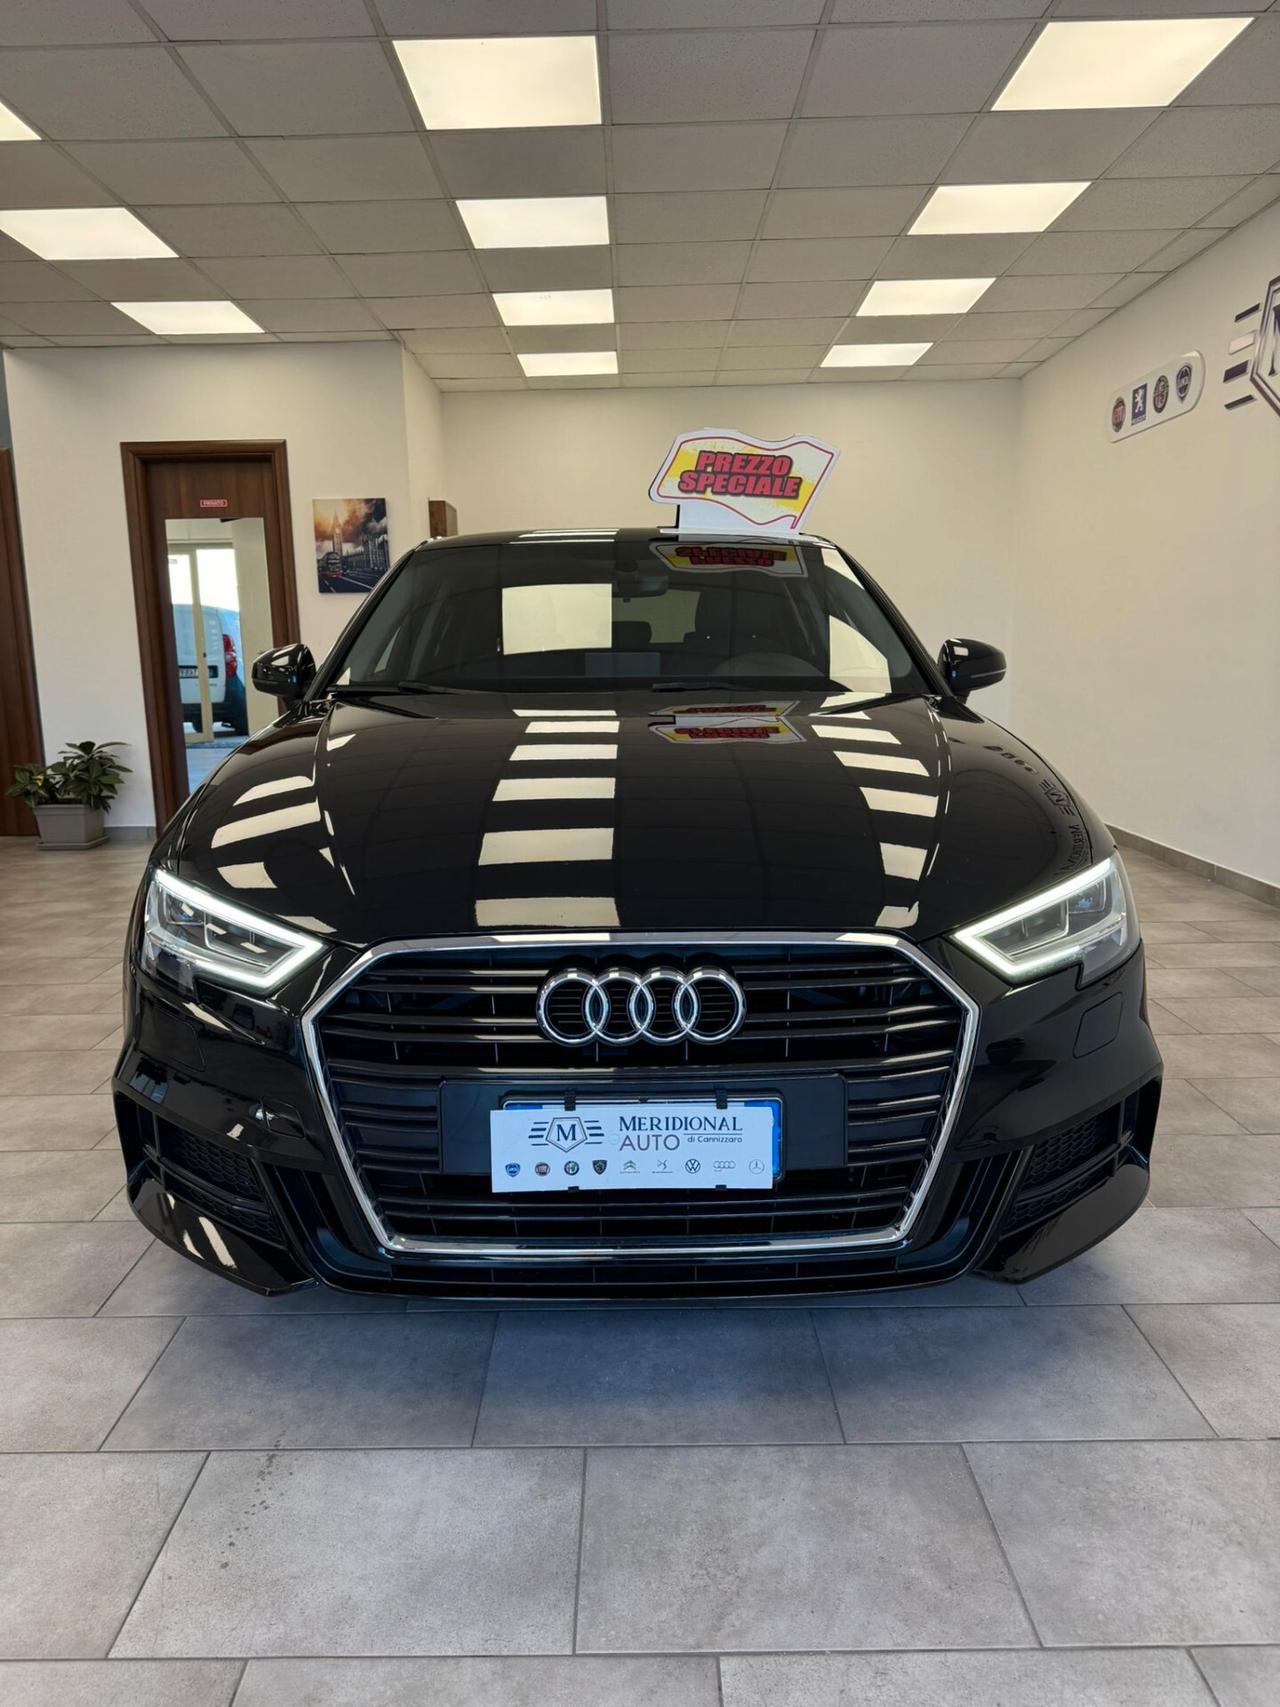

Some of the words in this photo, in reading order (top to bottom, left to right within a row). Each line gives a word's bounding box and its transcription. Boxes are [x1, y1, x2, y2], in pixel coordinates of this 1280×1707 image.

[695, 450, 793, 476] PREZZO
[679, 470, 803, 498] SPECIALE
[556, 1124, 577, 1141] M
[619, 1116, 743, 1132] MERIDIONAL
[619, 1134, 681, 1151] AUTO
[687, 1135, 695, 1143] di
[698, 1135, 743, 1143] Cannizzaro
